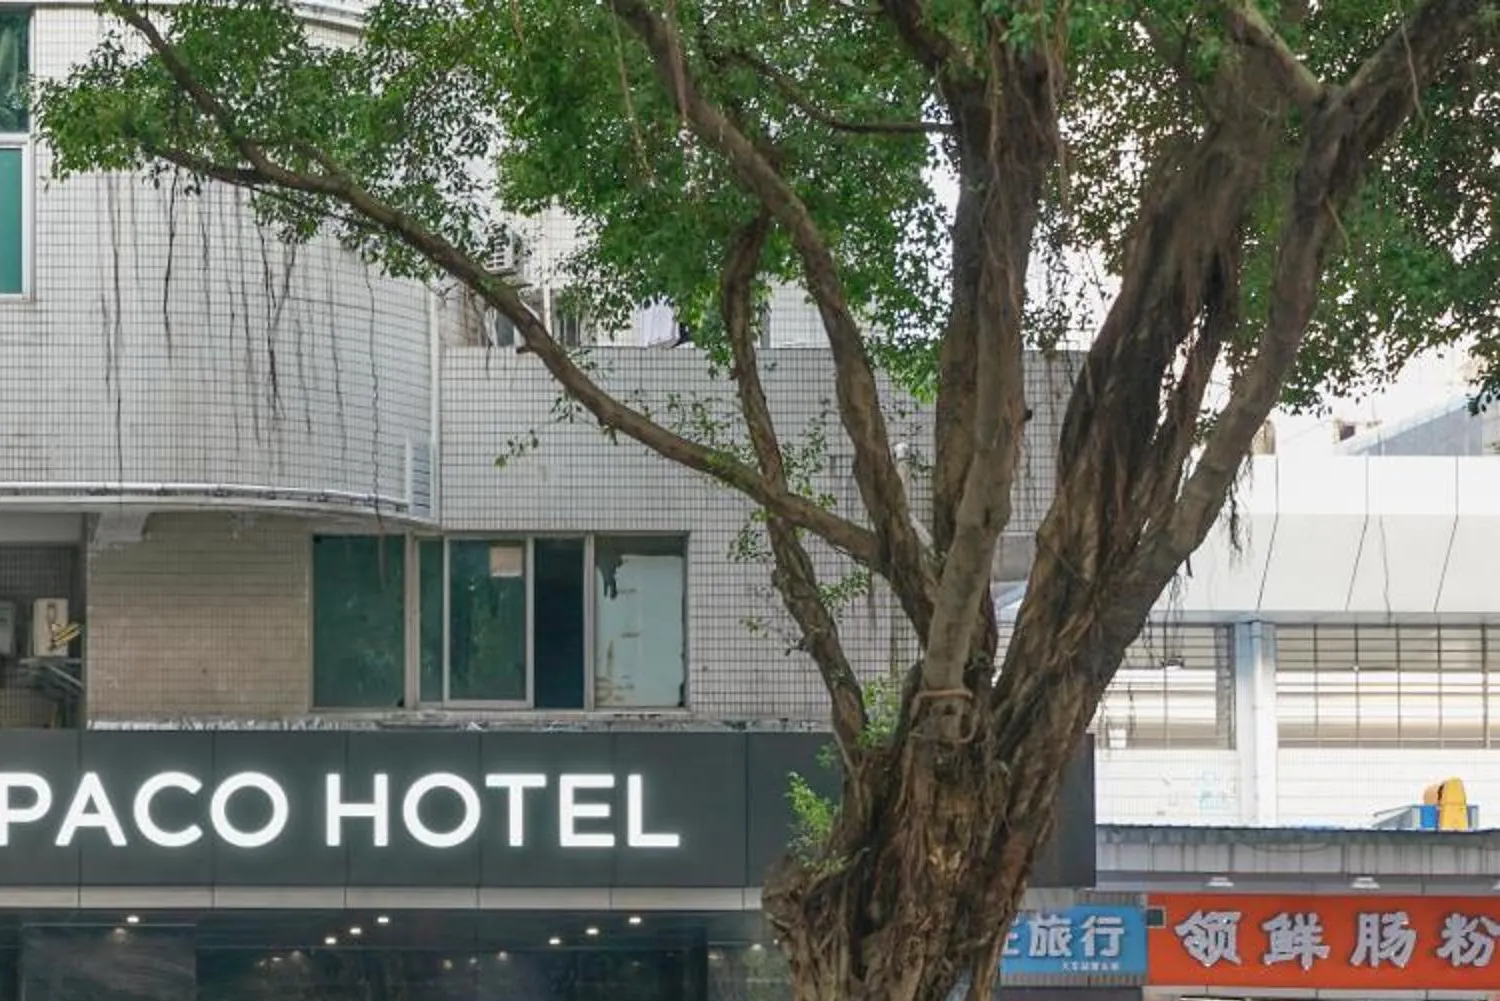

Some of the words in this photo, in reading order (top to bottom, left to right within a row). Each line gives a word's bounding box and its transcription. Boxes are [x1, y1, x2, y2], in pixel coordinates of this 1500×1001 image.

[325, 772, 680, 848] HOTEL
[1174, 909, 1500, 971] 领鲜肠粉
